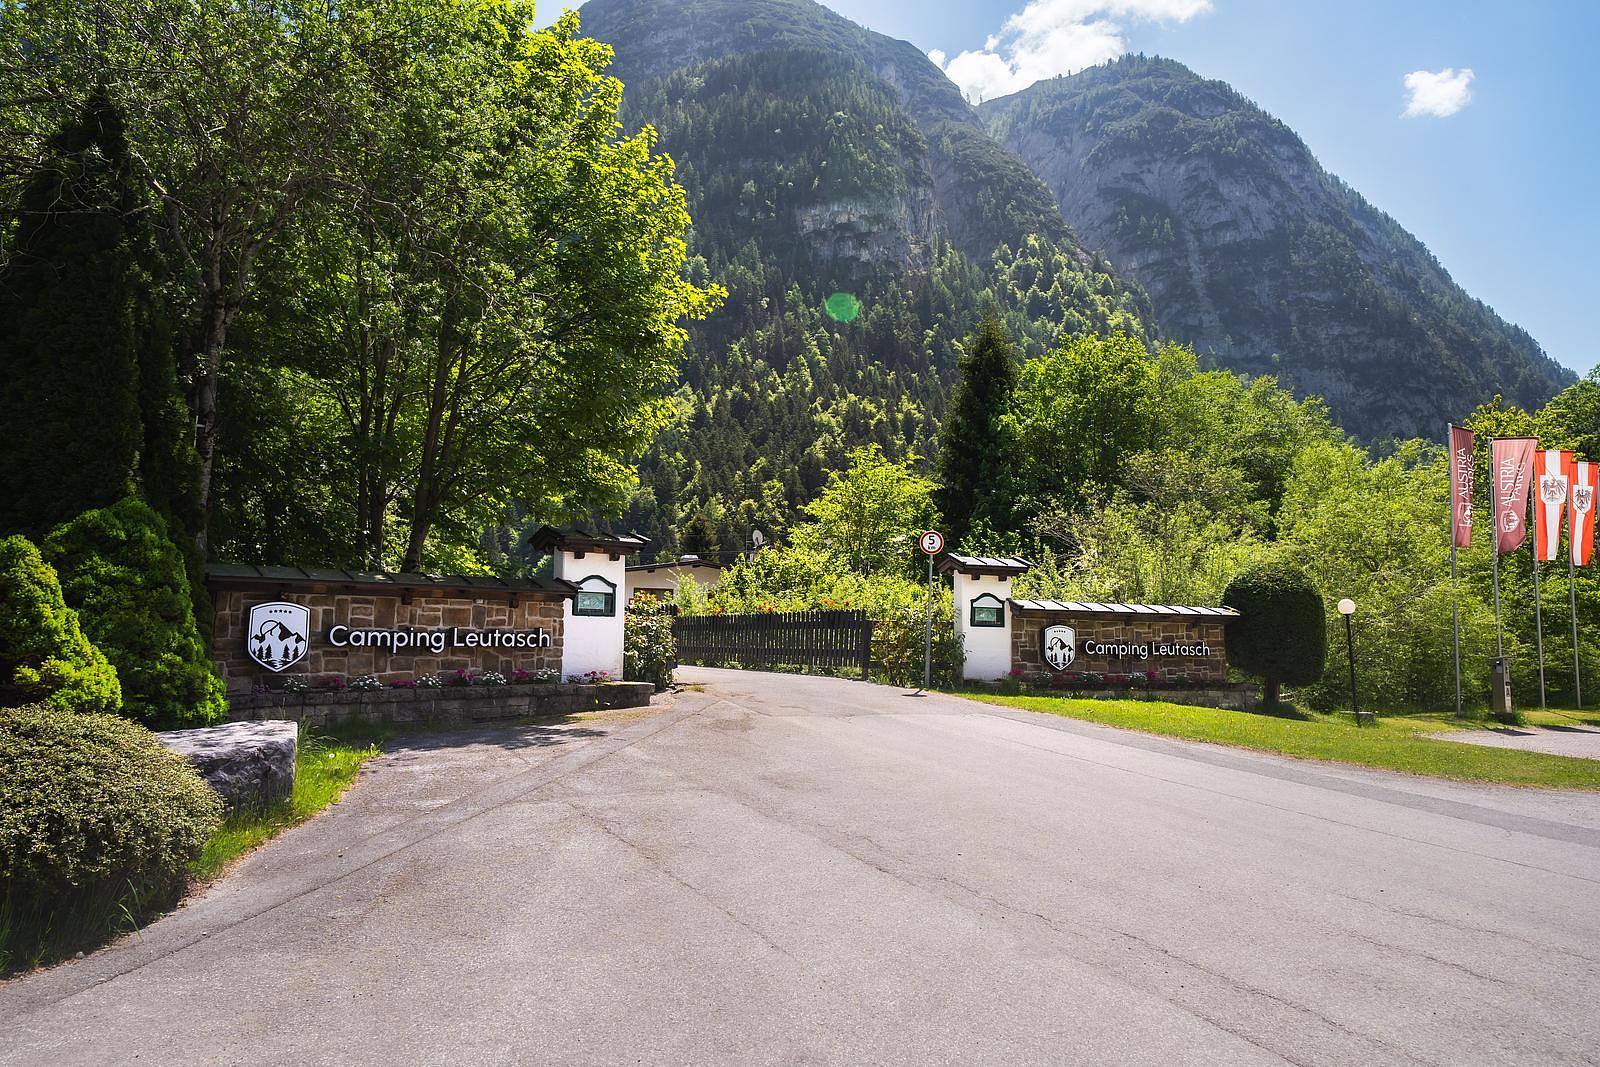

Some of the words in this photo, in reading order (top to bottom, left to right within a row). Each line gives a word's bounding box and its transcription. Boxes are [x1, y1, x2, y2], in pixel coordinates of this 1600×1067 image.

[1457, 447, 1469, 500] AUSTRIA
[1500, 457, 1514, 507] AUSTRIA
[928, 535, 935, 545] 5
[329, 625, 446, 653] Camping
[453, 627, 550, 648] Leutasch
[1085, 640, 1148, 660] Camping
[1152, 641, 1210, 656] Leutasch
